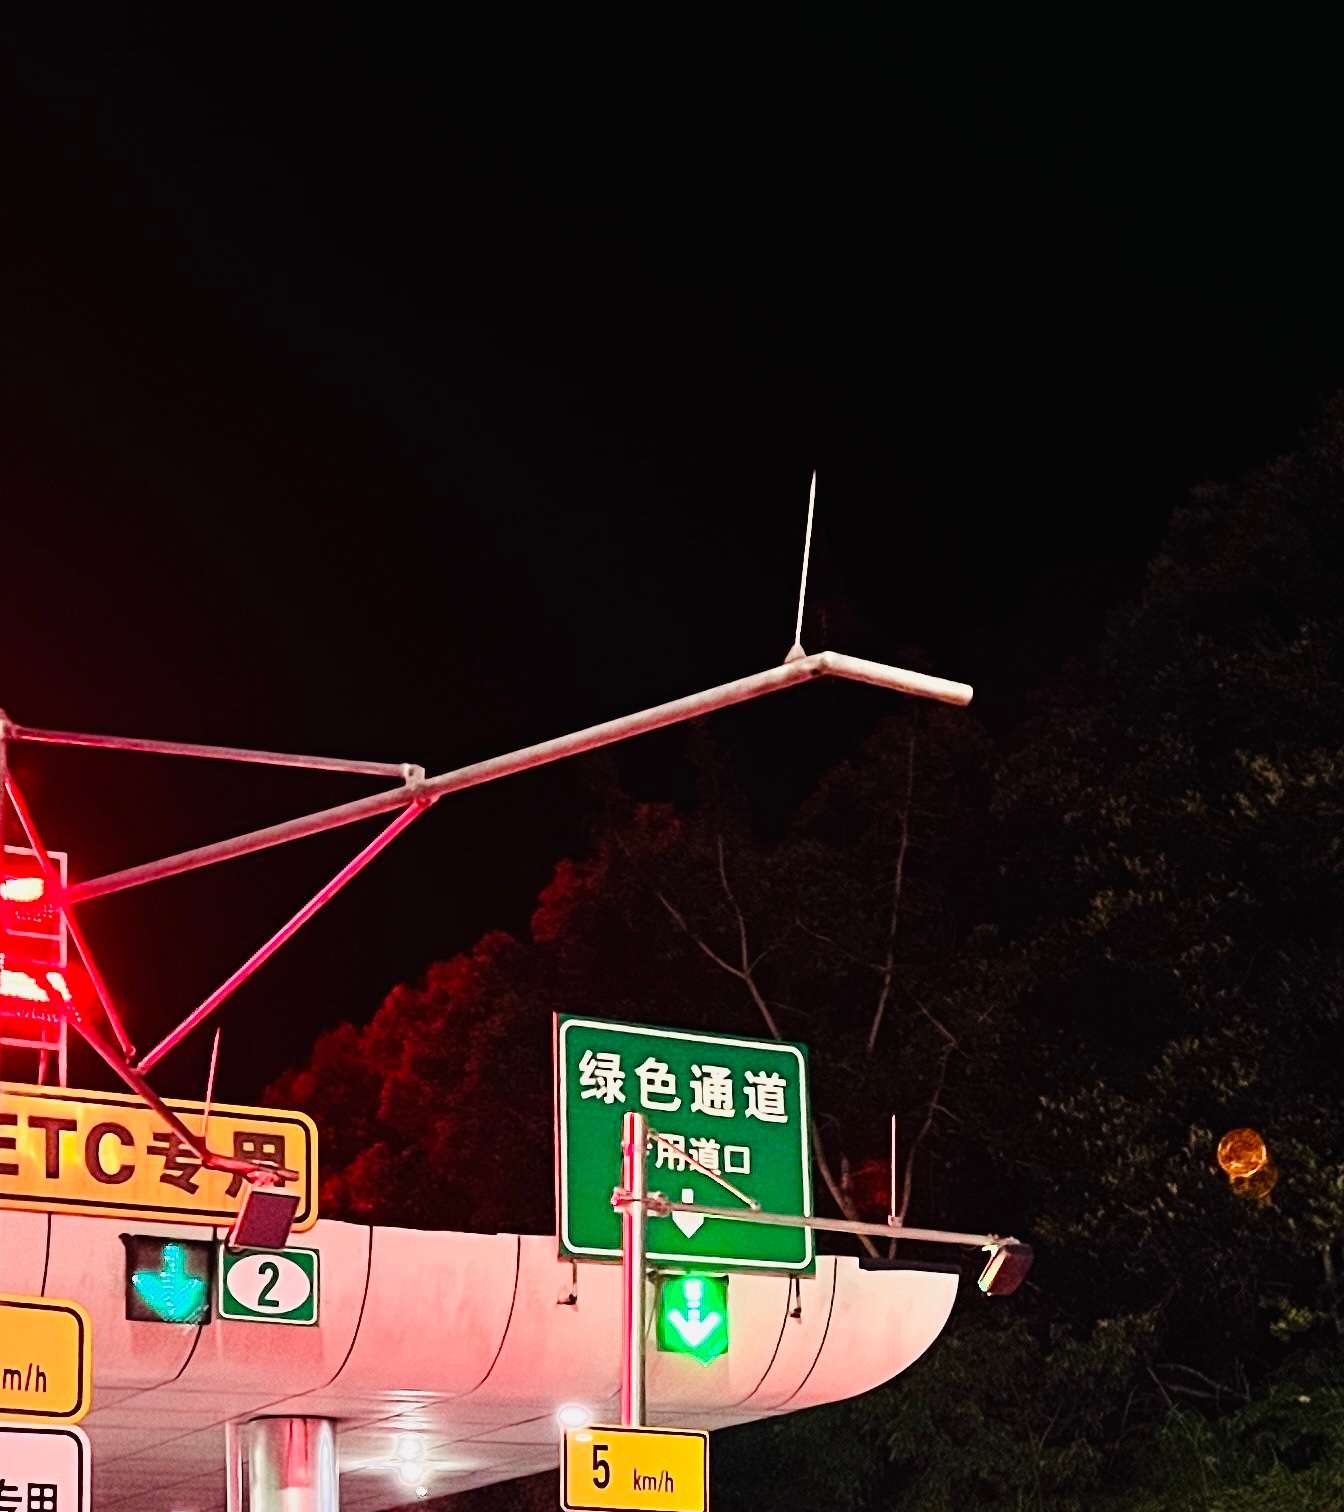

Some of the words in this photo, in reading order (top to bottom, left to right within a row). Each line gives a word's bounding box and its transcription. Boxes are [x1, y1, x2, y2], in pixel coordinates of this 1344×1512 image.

[578, 1050, 788, 1123] 绿色通道
[646, 1132, 751, 1175] 用道口
[257, 1261, 280, 1307] 2
[592, 1444, 610, 1489] 5
[633, 1470, 674, 1493] km/h
